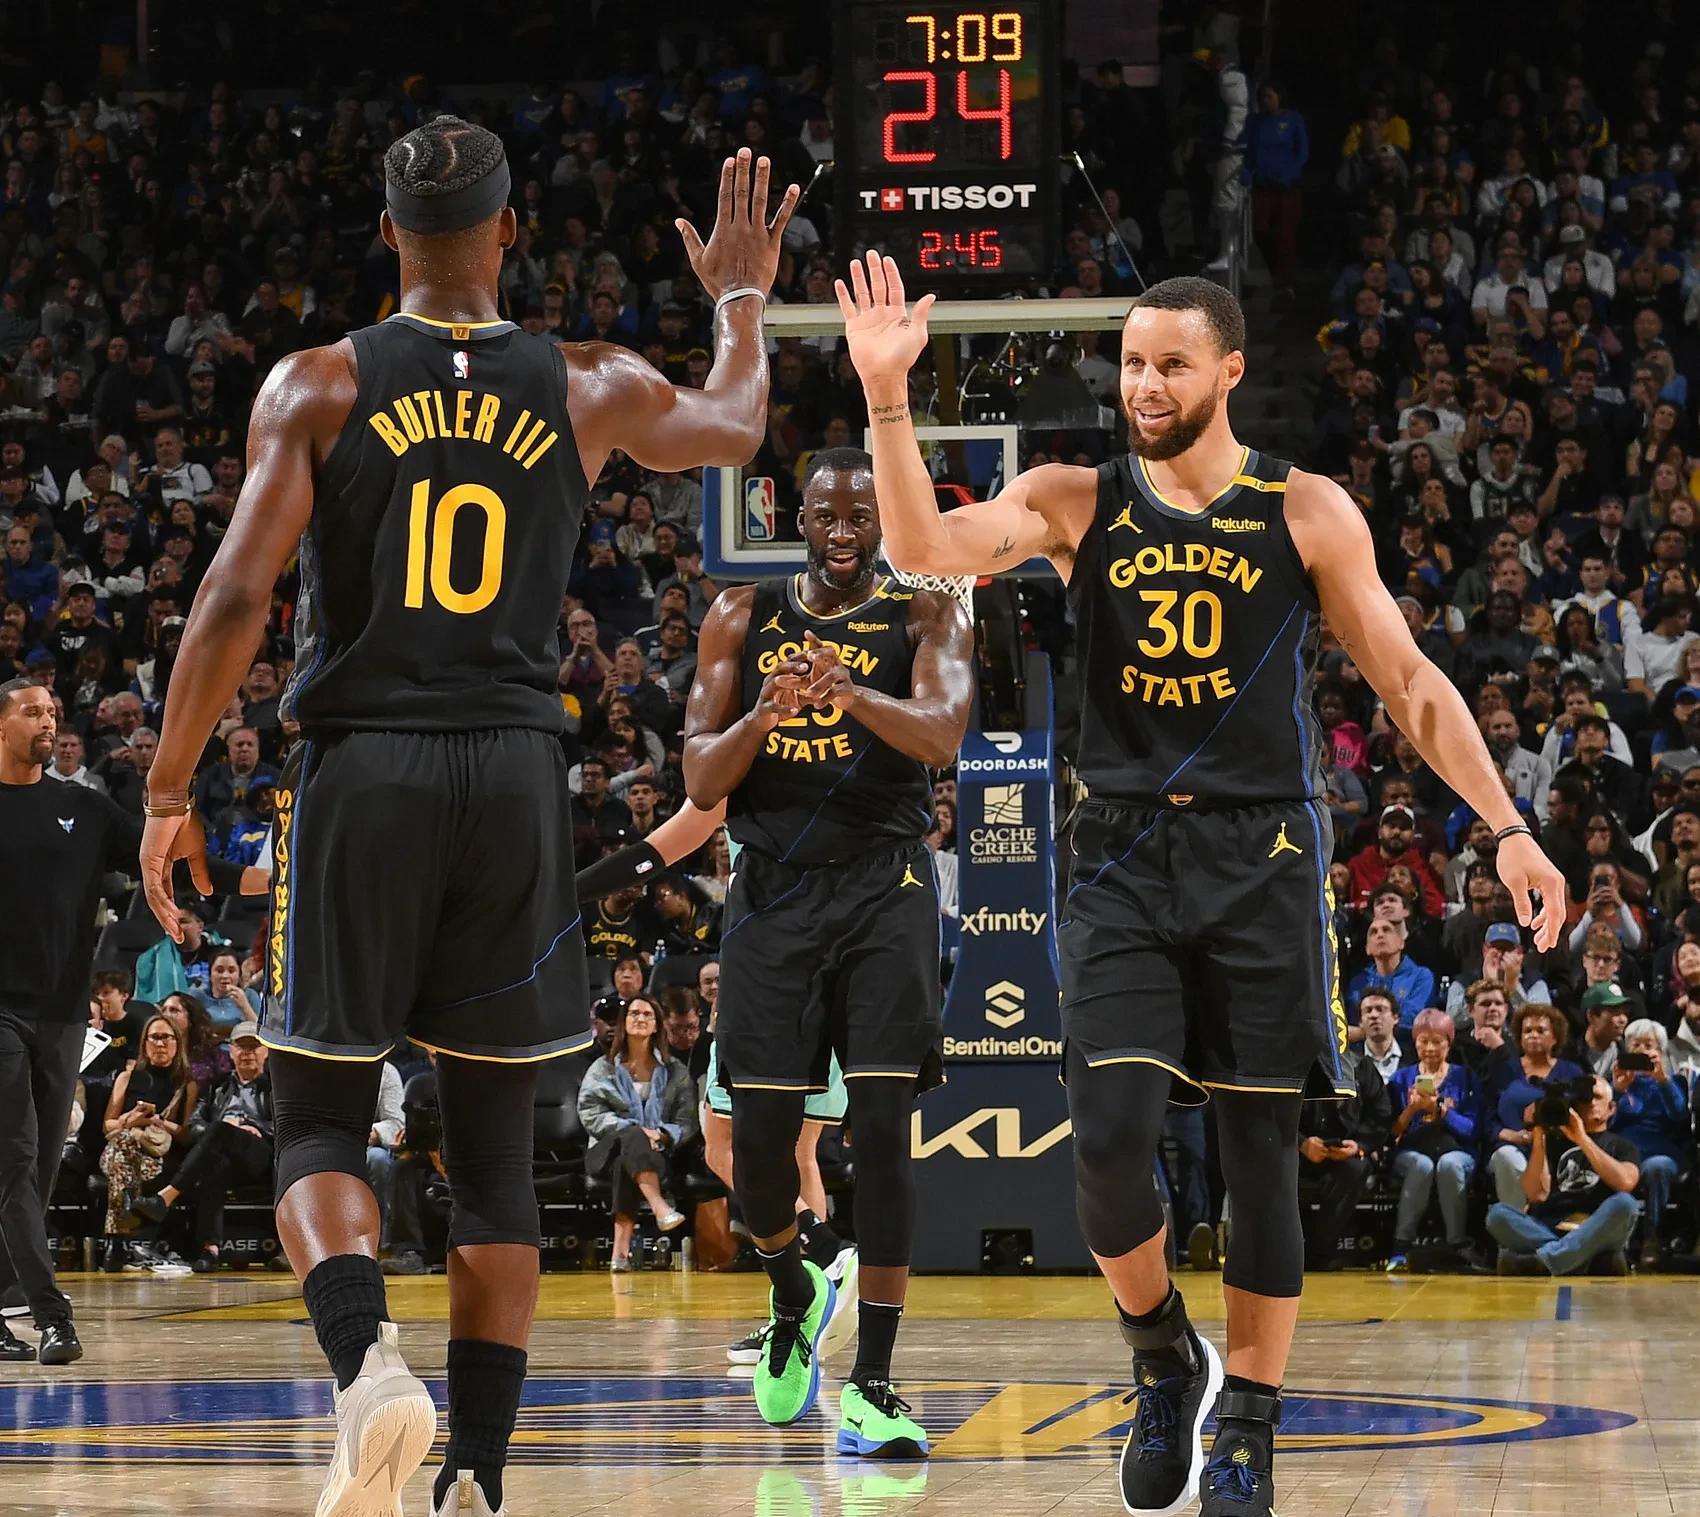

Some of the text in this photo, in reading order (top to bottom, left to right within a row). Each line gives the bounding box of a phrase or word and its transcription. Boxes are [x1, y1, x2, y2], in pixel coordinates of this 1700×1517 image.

[906, 13, 1022, 63] 7:09
[883, 68, 1011, 162] 24
[907, 184, 1037, 210] TISSOT
[920, 230, 1002, 269] 2:45
[368, 390, 559, 471] BUTLER III
[1212, 516, 1266, 532] Rakuten
[404, 478, 507, 614] 10
[1108, 543, 1264, 594] GOLDEN
[847, 621, 889, 632] Rakuten
[1137, 590, 1223, 658] 30
[1121, 664, 1237, 707] STATE
[765, 731, 853, 762] STATE
[959, 758, 1049, 772] DOORDASH
[970, 828, 1037, 842] CACHE
[970, 842, 1037, 856] CREEK
[971, 855, 1038, 864] CASINO RESORT
[270, 788, 292, 997] WARRIORS
[960, 906, 1047, 936] xfinity
[591, 932, 637, 947] GOLDEN
[219, 1239, 257, 1251] ASE
[596, 1237, 652, 1249] CHE
